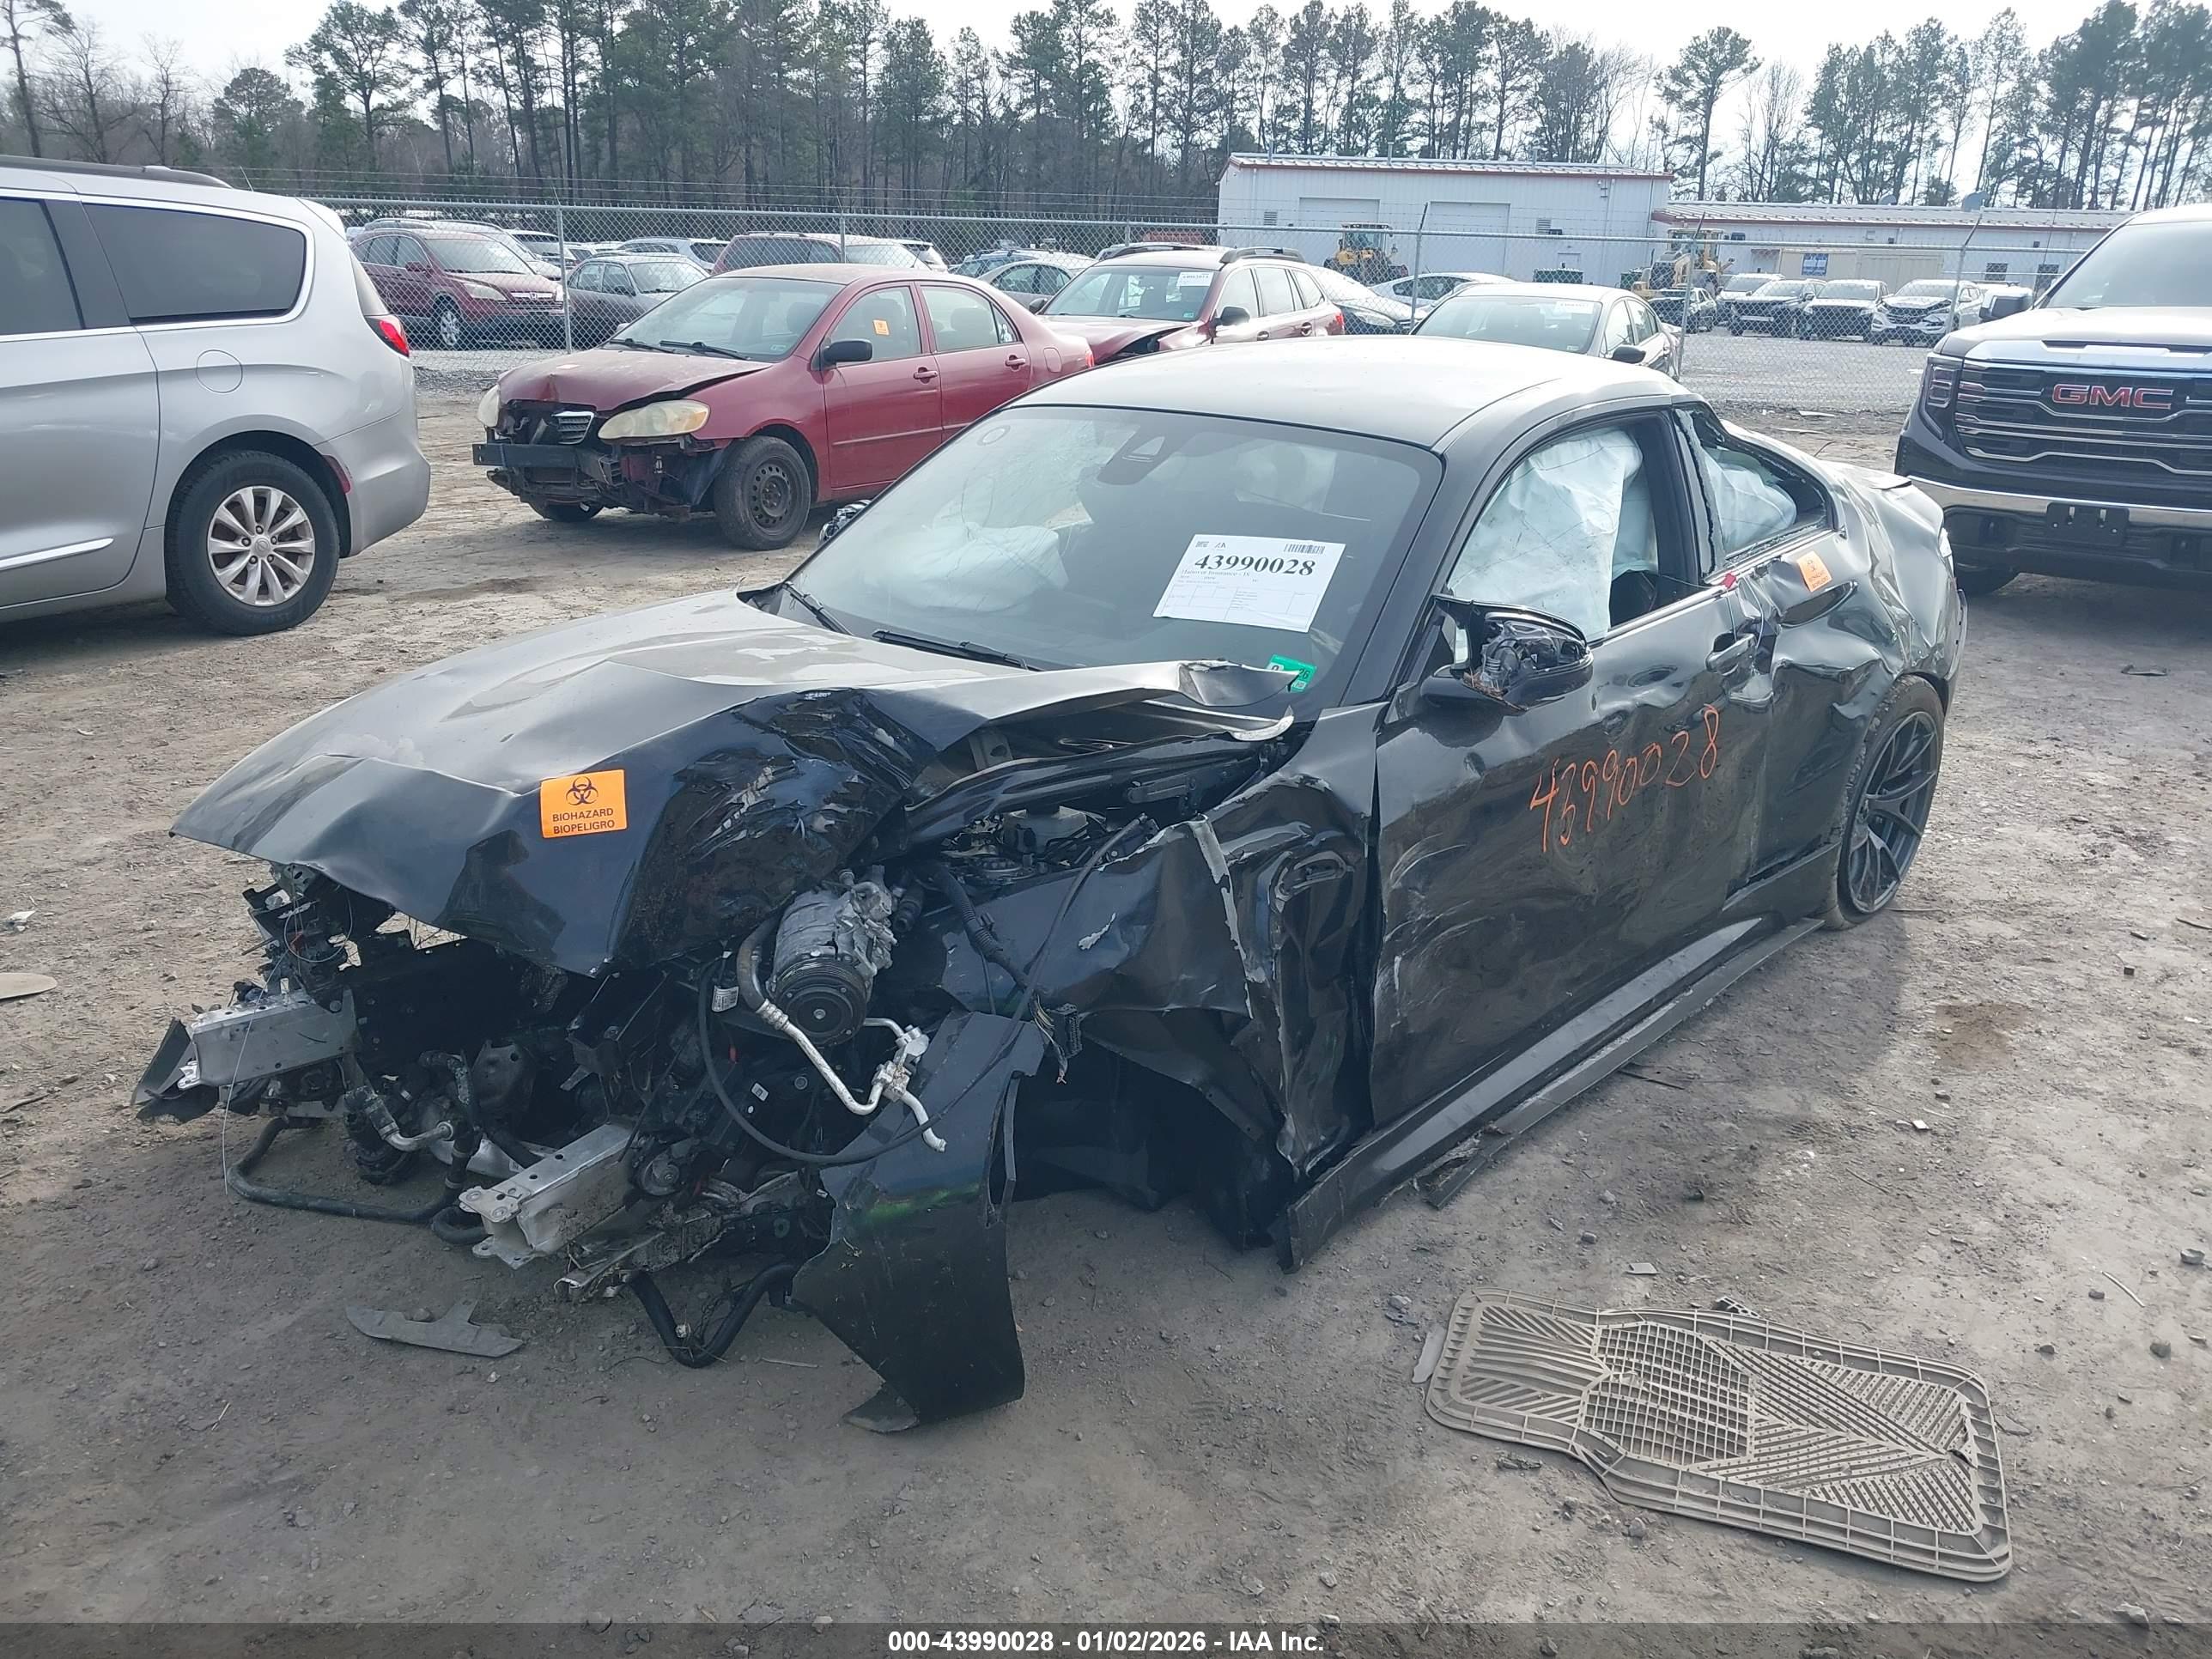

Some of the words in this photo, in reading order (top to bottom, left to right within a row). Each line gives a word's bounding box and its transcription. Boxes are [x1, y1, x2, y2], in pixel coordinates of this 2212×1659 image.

[2051, 383, 2174, 410] GMC
[1194, 554, 1316, 576] 43990028
[1528, 703, 1719, 853] 43990028
[552, 807, 614, 822] BIOHAZARD
[553, 819, 615, 835] BIOPELIGRO
